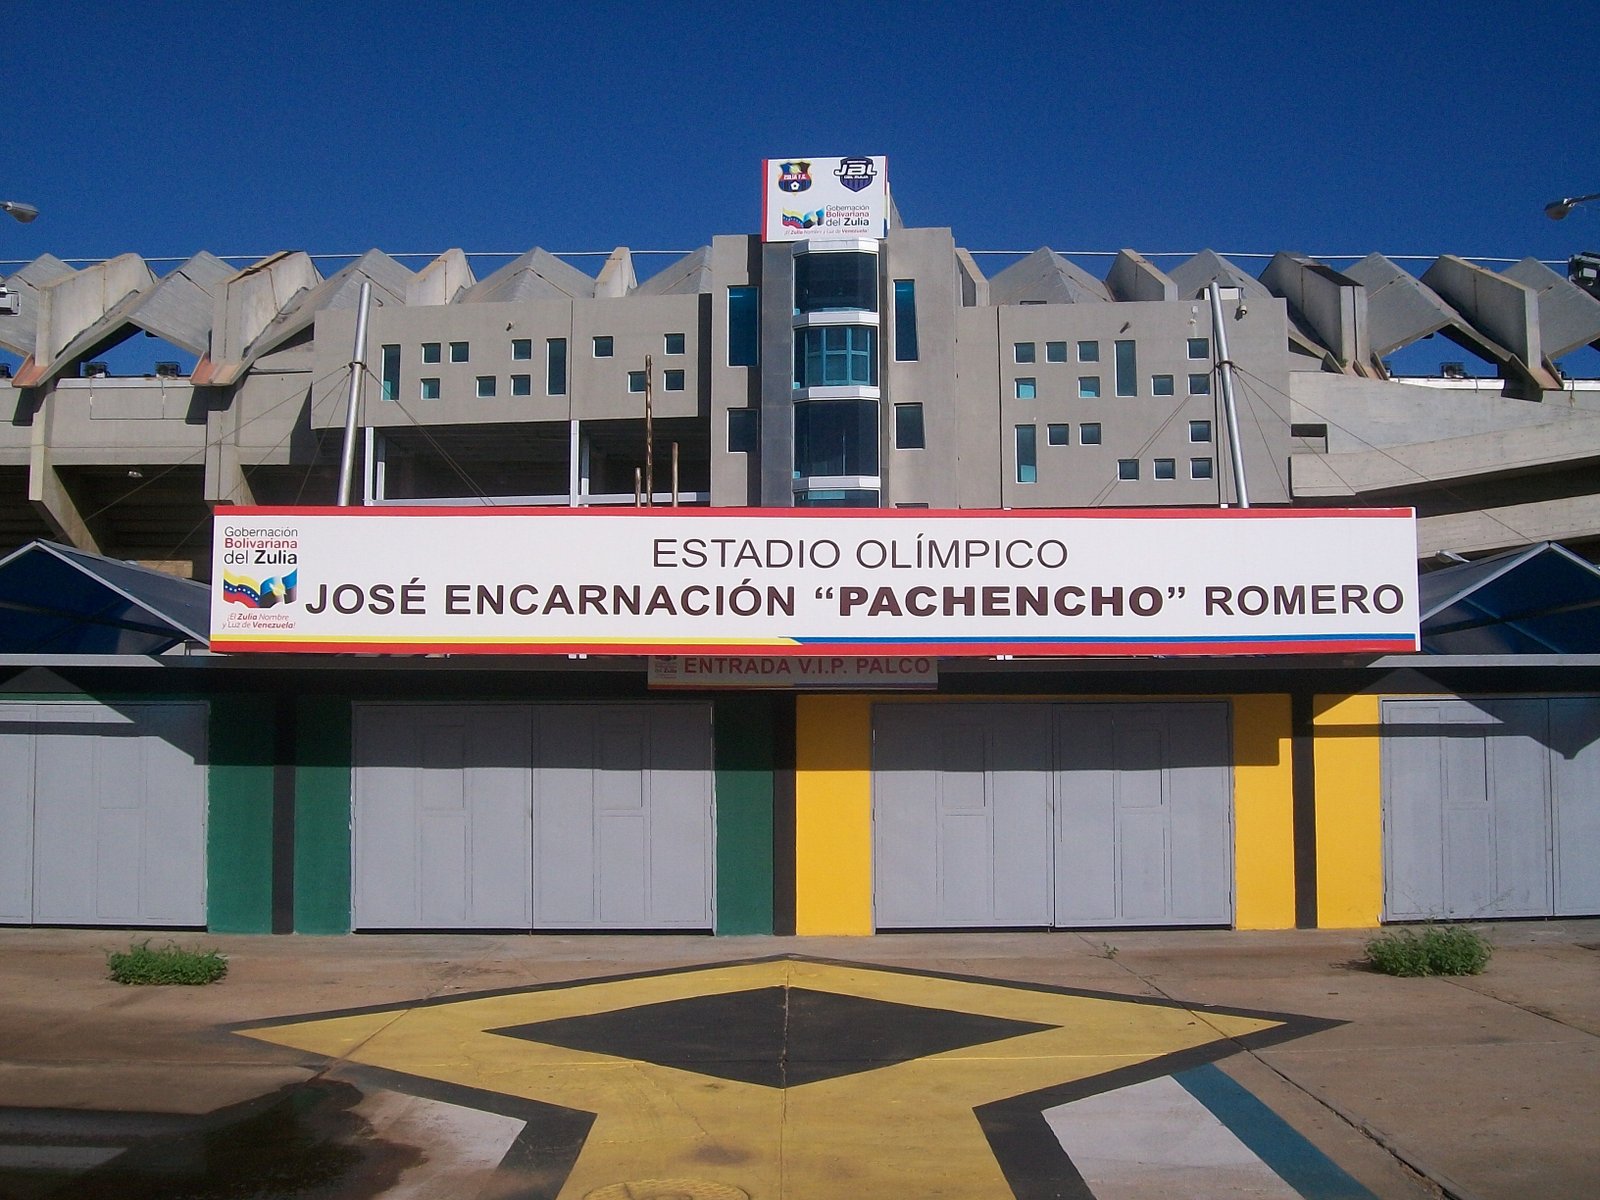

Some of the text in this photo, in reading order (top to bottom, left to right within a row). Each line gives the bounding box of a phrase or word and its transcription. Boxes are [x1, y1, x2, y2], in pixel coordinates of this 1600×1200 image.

[835, 164, 876, 175] JBL
[826, 218, 870, 226] del Zulia
[224, 526, 298, 537] Gobernación
[224, 538, 298, 549] Bolivariana
[654, 533, 1067, 568] ESTADIO OLÍMPICO
[224, 550, 298, 564] del Zulia
[306, 578, 1403, 616] JOSÉ ENCARNACIÓN “PACHENCHO” ROMERO
[237, 613, 258, 621] Zulia
[259, 613, 289, 621] Nombre
[227, 621, 241, 629] Luz
[242, 621, 253, 629] de
[253, 621, 296, 629] Venezuela!
[684, 657, 791, 674] ENTRADA
[799, 657, 848, 674] V.I.P.
[856, 657, 931, 674] PALCO
